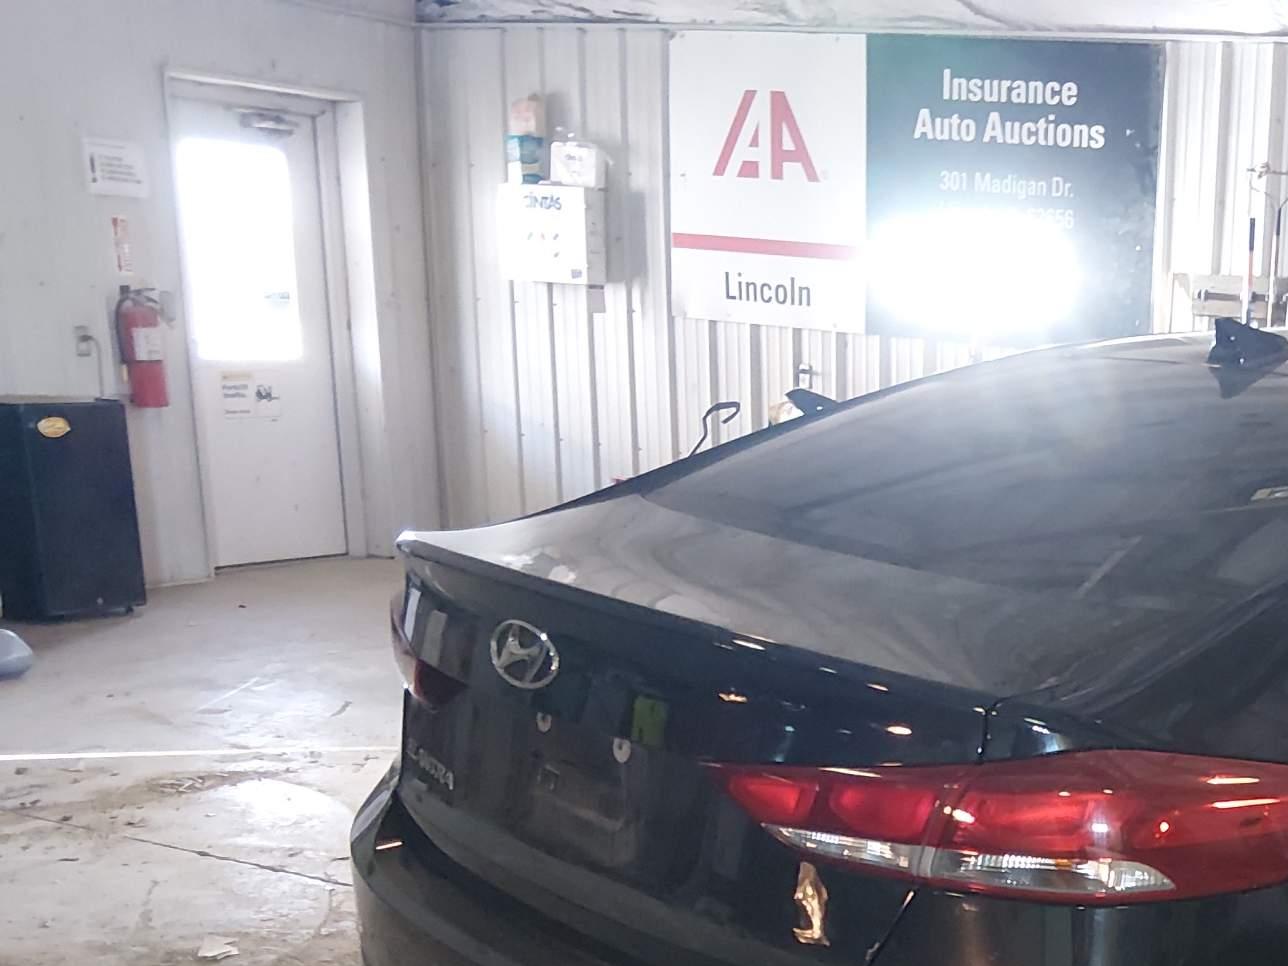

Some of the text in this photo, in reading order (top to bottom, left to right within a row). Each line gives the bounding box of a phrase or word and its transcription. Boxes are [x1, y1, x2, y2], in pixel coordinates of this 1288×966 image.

[942, 68, 1078, 106] Insurance
[913, 108, 1106, 149] Auto Auctions
[939, 170, 1074, 200] 301 Madigan Dr.
[724, 271, 812, 307] Lincoln
